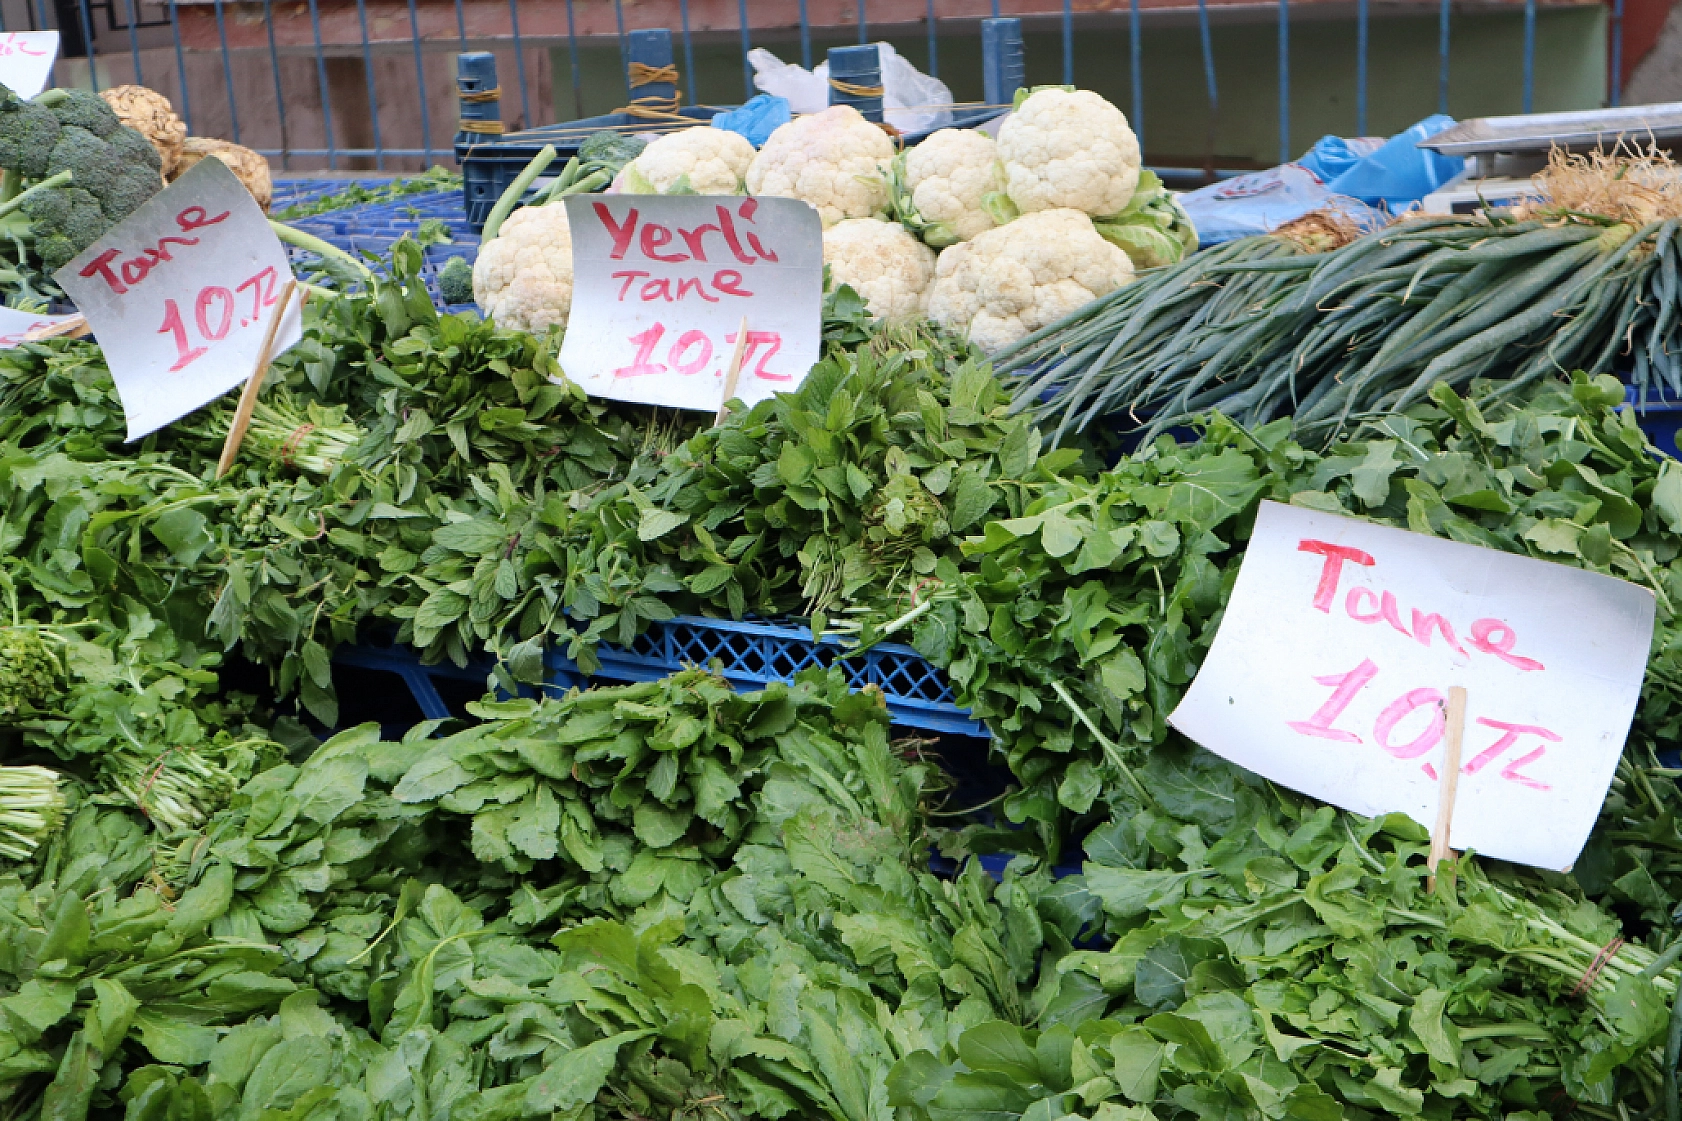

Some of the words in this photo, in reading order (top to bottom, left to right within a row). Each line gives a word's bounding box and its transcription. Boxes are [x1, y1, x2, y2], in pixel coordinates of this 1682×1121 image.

[79, 205, 231, 294] Tane
[592, 196, 779, 266] Yerli
[611, 269, 755, 303] Tane
[1297, 538, 1546, 672] Tane
